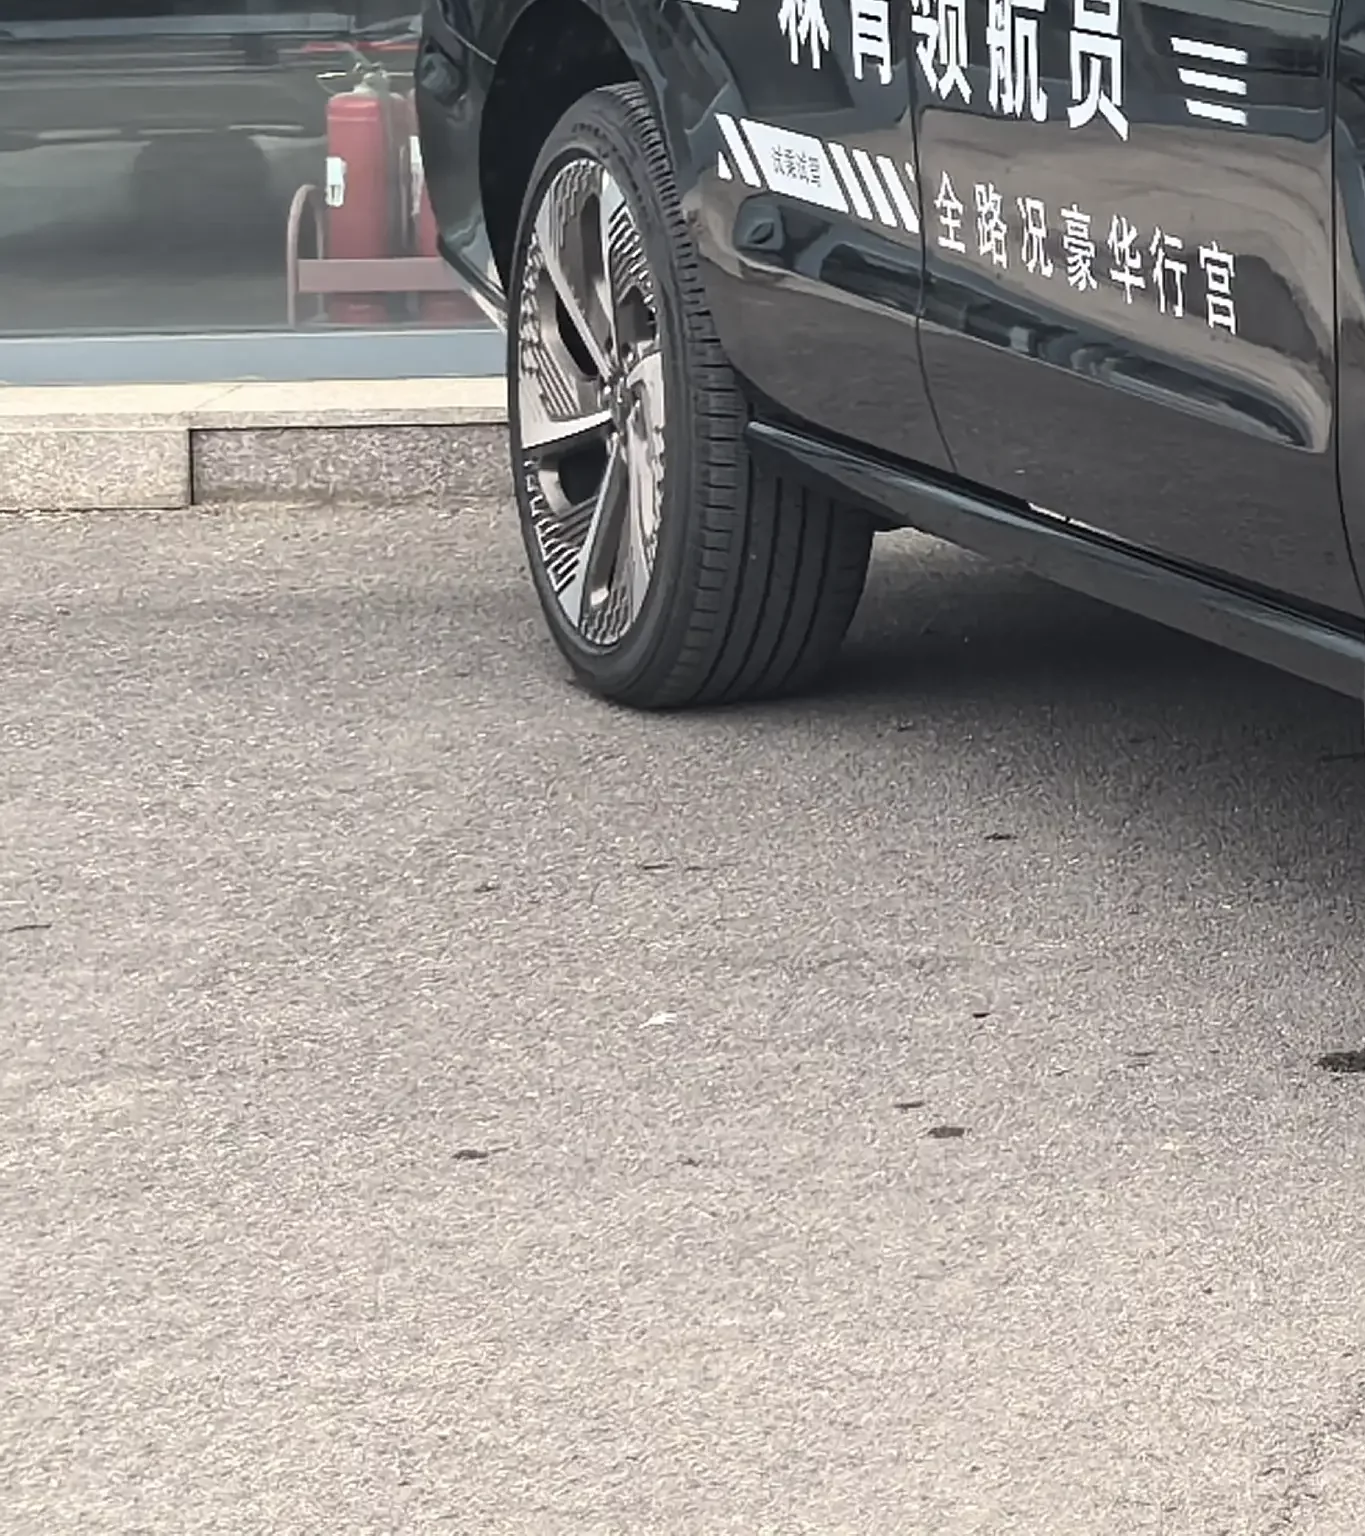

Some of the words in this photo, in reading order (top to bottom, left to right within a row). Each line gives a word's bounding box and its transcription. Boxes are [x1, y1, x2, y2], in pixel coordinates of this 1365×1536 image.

[934, 170, 1236, 335] 全路况豪华行宫
